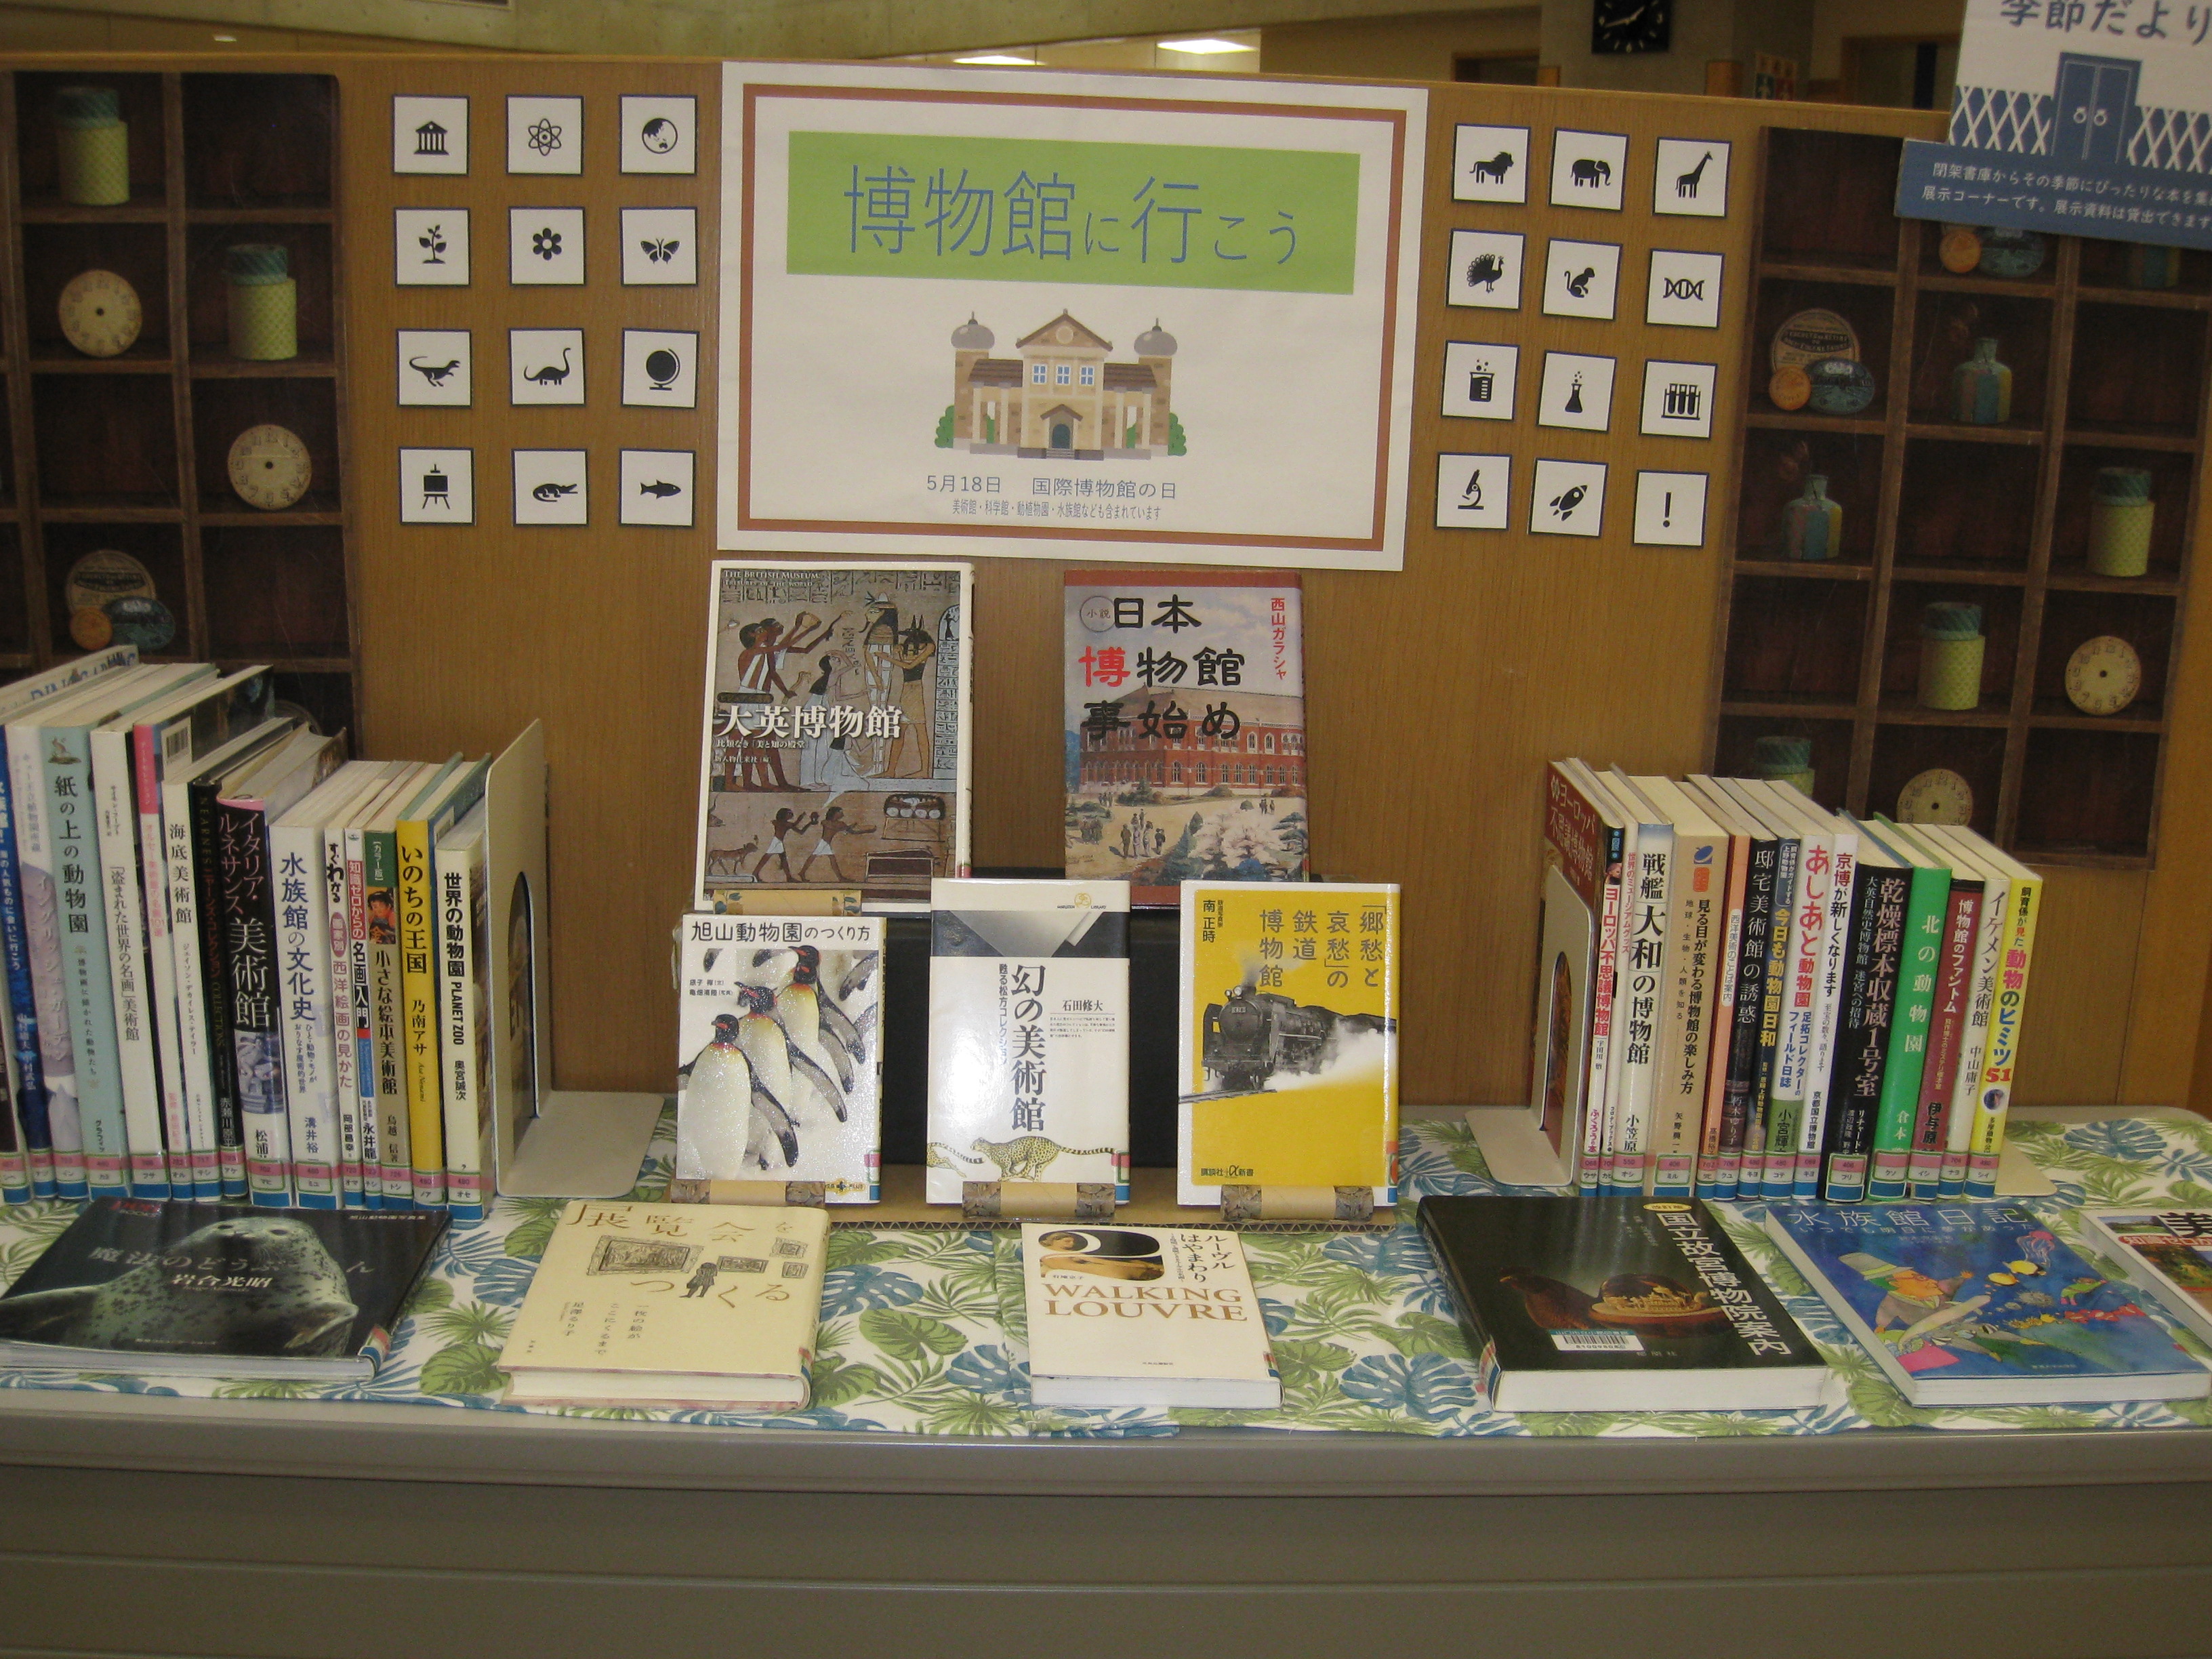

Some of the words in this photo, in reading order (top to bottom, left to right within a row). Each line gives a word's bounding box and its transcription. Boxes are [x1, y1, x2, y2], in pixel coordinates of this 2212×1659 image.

[844, 165, 1297, 265] 博物館に行こう
[926, 474, 1001, 493] 5月18日
[1032, 477, 1176, 499] 国際博物館の日
[952, 498, 1162, 520] 美術館・科学館・動植物園・水族館なども含まれています
[1086, 609, 1111, 619] 小説
[1113, 594, 1202, 634] 日本
[1271, 597, 1287, 680] 西山ガラシャ
[1078, 646, 1245, 687] 博物館
[716, 704, 902, 739] 大英博物館
[1081, 700, 1240, 740] 事始め
[54, 775, 89, 934] 紙の上の動物園
[169, 823, 192, 924] 海底美術館
[220, 813, 244, 915] ルネサンス
[327, 842, 344, 903] すぐわかる
[280, 851, 316, 1021] 水族館の文化史
[348, 861, 365, 939] 知識ゼロからの
[401, 846, 427, 975] いのちの王国
[444, 872, 465, 978] 世界の動物園
[691, 921, 870, 943] 旭山動物園のつくり方
[1203, 899, 1216, 943] 南正時
[1292, 909, 1318, 961] 鉄道
[1621, 852, 1637, 954] 世界のミュージアムグッズ
[1736, 849, 1775, 1024] 邸宅美術館の誘惑
[1794, 844, 1829, 1008] あしあと動物園
[1823, 853, 1853, 997] 京博が新しくなります
[1856, 876, 1879, 966] 大英自然史博物館
[110, 866, 140, 1042] 「盗まれた世界の名画」美術館
[230, 917, 271, 1027] 美術館
[1258, 909, 1284, 987] 博物館
[1324, 912, 1351, 989] 哀愁」の
[1359, 905, 1387, 987] 「郷愁と
[1593, 888, 1619, 1037] ヨーロッパ不思議博物館
[1626, 853, 1666, 1065] 戦艦大和の博物館
[1759, 908, 1791, 1047] 今日も動物園日和
[1904, 915, 1941, 1053] 北の動物園
[1943, 899, 1973, 1014] 博物館のファントム
[1971, 891, 2006, 1028] イケメン美術館
[1986, 886, 2032, 1083] 飼育係が見た動物のヒミツ51
[353, 941, 370, 1029] 名画入門
[375, 950, 398, 1095] 小さな絵本美術館
[451, 982, 464, 1026] PLANET
[1062, 1000, 1103, 1012] 石田修大
[1680, 899, 1711, 1095] 見る目が変わる博物館の楽しみ方
[1848, 970, 1866, 1029] 迷宮への招待
[1853, 878, 1906, 1097] 乾燥標本収蔵1号室
[333, 960, 353, 1088] 西洋絵画の見かた
[411, 1000, 427, 1056] 乃南アサ
[453, 1027, 464, 1046] ZOO
[1010, 964, 1047, 1132] 幻の美術館
[1779, 1011, 1799, 1088] フィールド日誌
[1965, 1046, 1982, 1096] 中山庸子
[255, 1128, 269, 1159] 松浦
[1587, 1109, 1600, 1153] ふくろうの本
[1623, 1114, 1639, 1152] 小笠原
[1729, 1095, 1742, 1145] 朽木ゆり子
[1774, 1109, 1792, 1153] 小宮輝
[1805, 1091, 1822, 1149] 京都国立博物館
[1894, 1109, 1910, 1151] 倉本
[1921, 1102, 1943, 1151] 伊与原
[567, 1204, 795, 1243] 展覧会を
[1204, 1235, 1236, 1269] ルーヴル
[1788, 1208, 2028, 1227] 水族館日記
[630, 1280, 790, 1309] つくる
[1044, 1283, 1242, 1303] WALKING
[1181, 1233, 1208, 1283] はやまわり
[1656, 1212, 1793, 1356] 国立故宮博物院案内
[1046, 1300, 1248, 1322] LOUVRE
